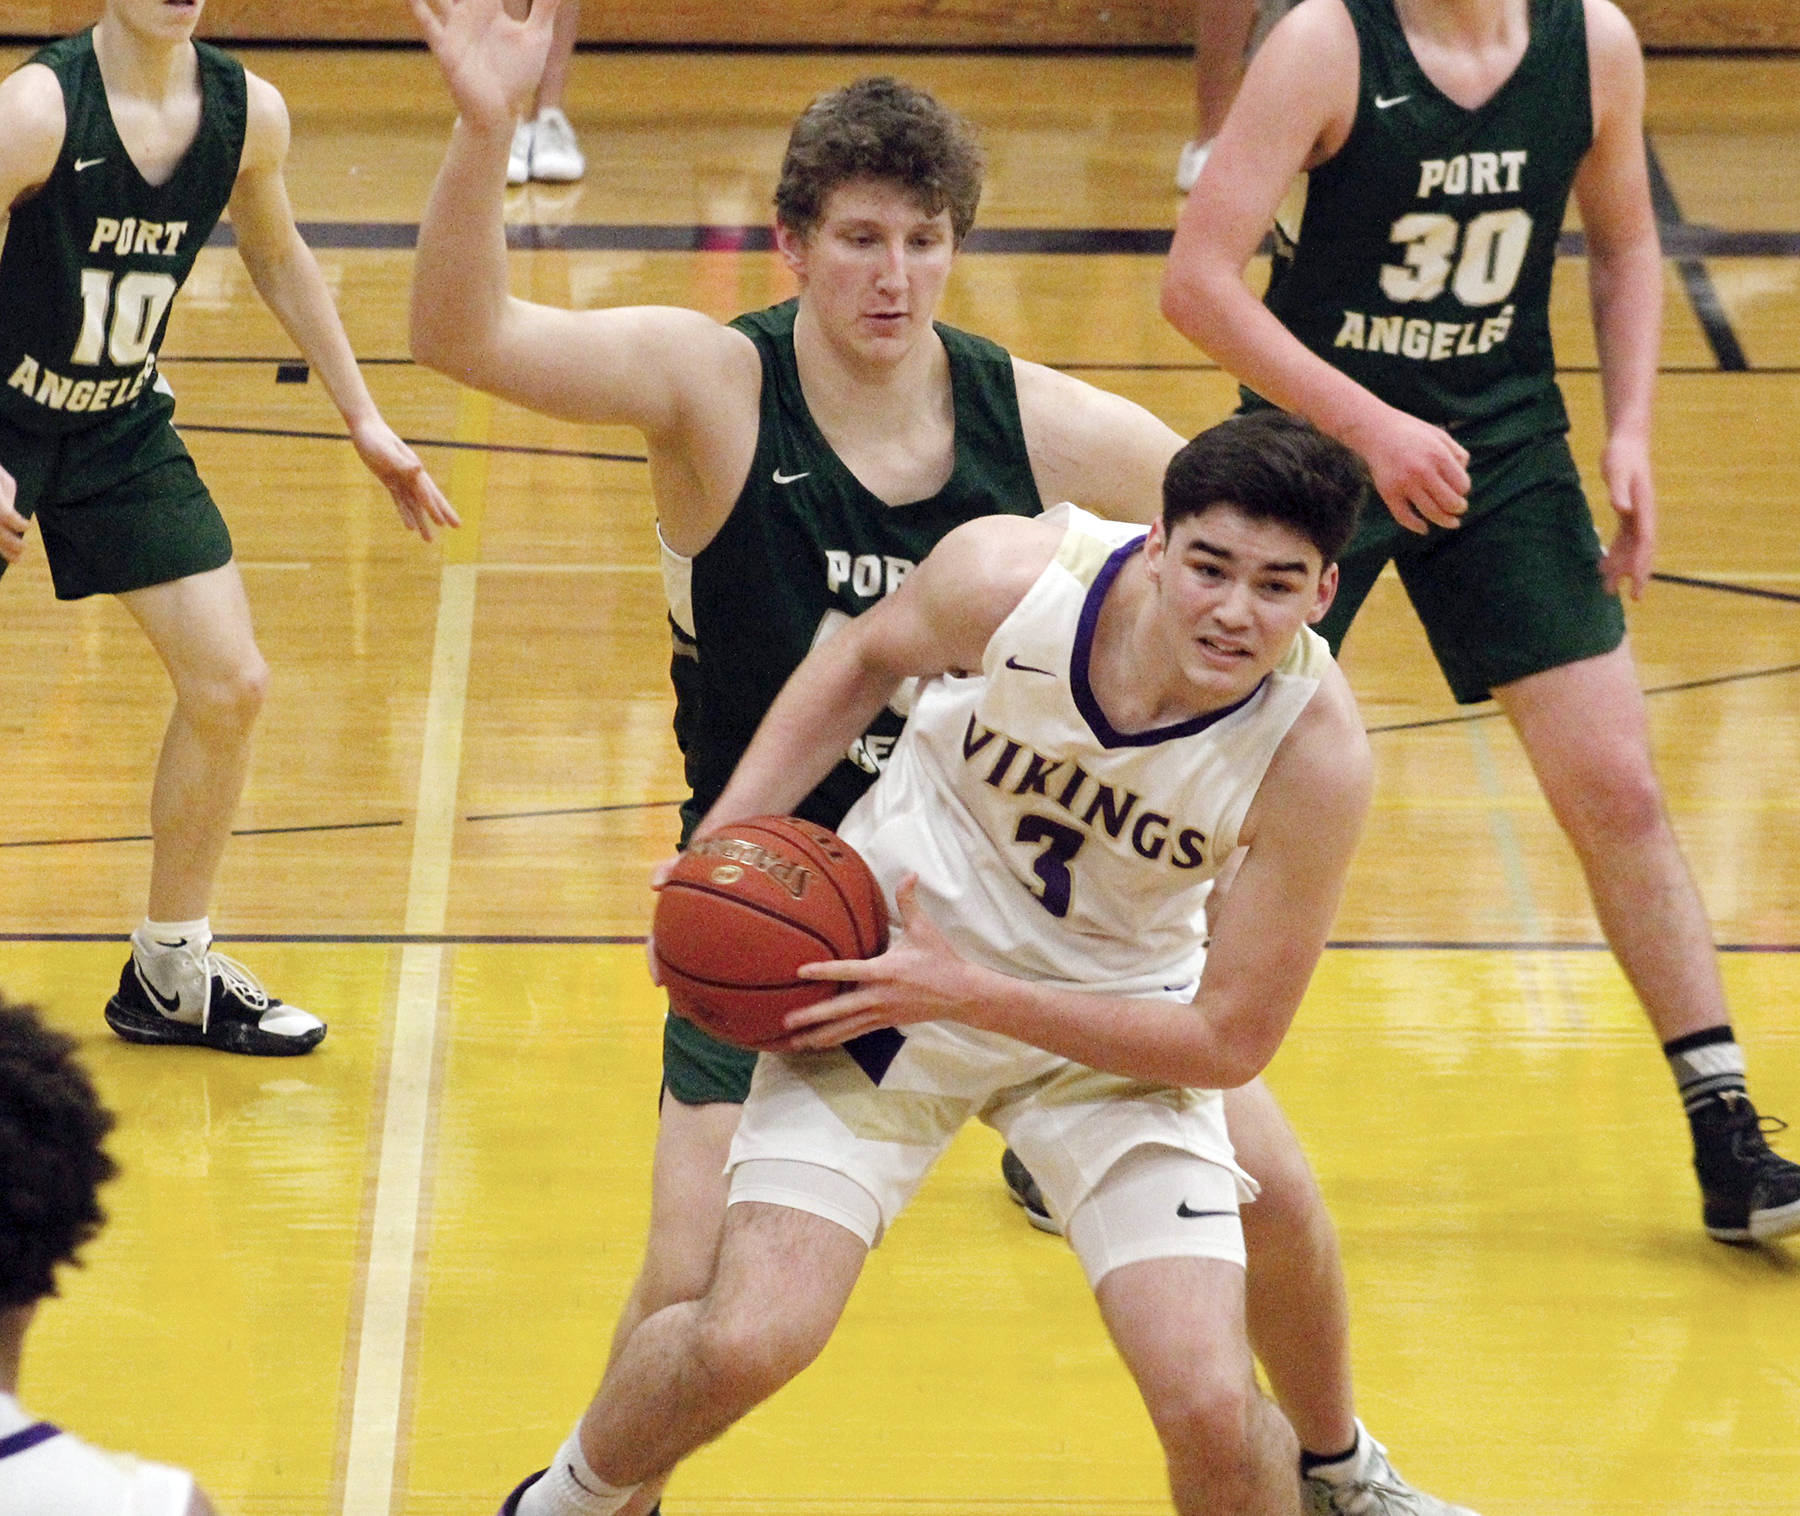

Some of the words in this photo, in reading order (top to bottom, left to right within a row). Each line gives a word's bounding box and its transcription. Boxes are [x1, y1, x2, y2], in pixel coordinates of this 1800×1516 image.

[1416, 150, 1527, 198] PORT
[89, 216, 188, 256] PORT
[1378, 207, 1533, 307] 30
[70, 267, 177, 366] 10
[825, 549, 916, 597] POR
[962, 709, 1208, 870] VIKINGS
[1014, 813, 1086, 919] 3
